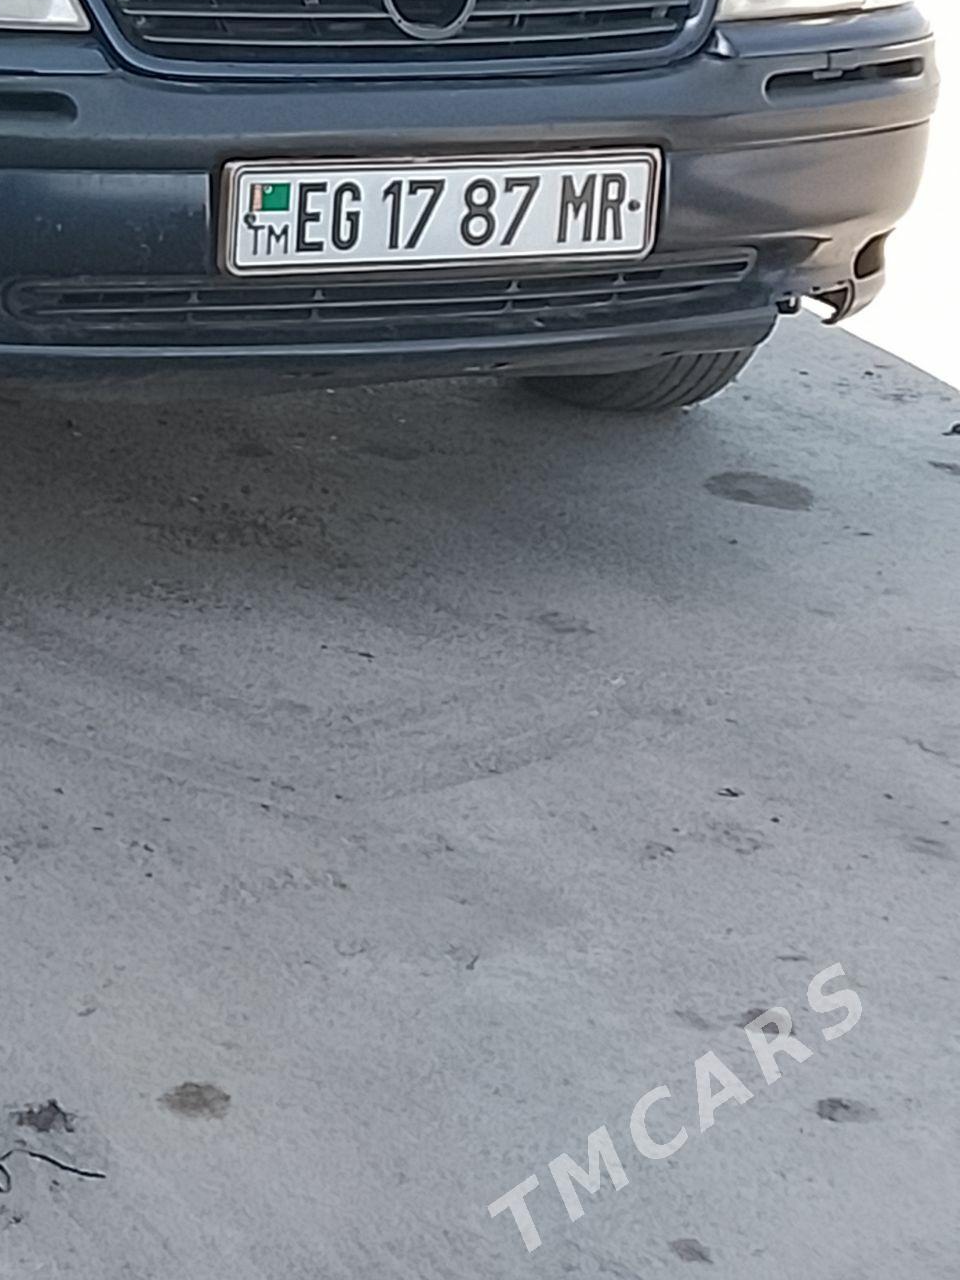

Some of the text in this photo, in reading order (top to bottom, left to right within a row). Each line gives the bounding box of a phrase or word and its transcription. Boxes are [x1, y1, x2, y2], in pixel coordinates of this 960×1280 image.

[248, 223, 289, 256] TM
[295, 173, 626, 253] EG 17 87 MR
